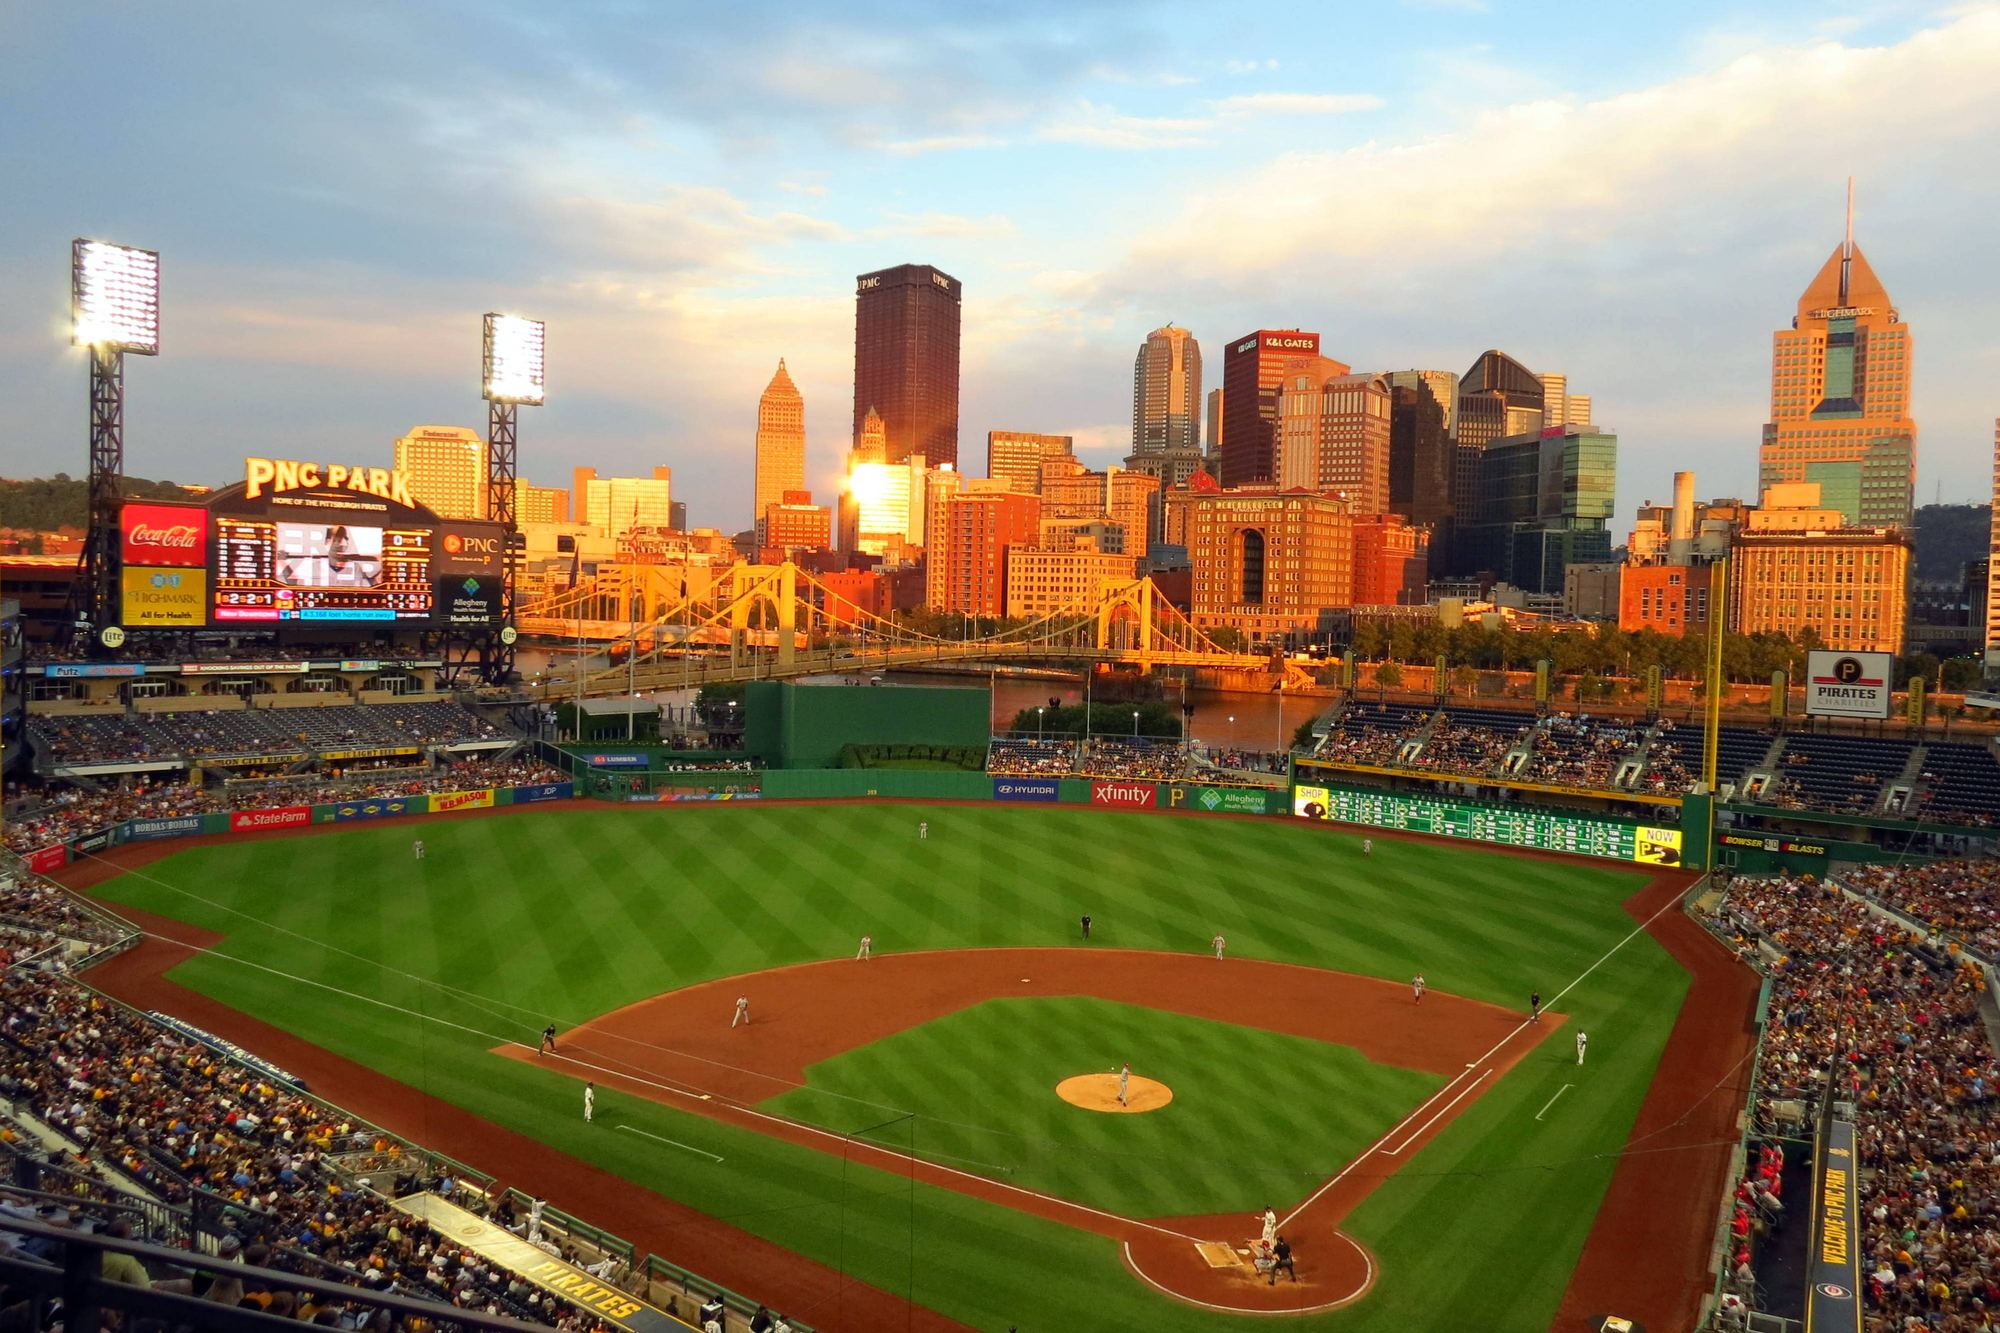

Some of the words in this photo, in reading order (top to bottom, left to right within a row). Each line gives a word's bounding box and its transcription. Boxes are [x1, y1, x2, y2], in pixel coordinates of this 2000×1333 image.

[932, 272, 950, 290] UPMC
[1266, 338, 1282, 346] K&L
[1284, 340, 1314, 349] GATES
[246, 457, 322, 500] PNC
[328, 464, 416, 510] PARK
[272, 497, 294, 505] HOME
[320, 500, 360, 509] PITTSBURGH
[361, 502, 387, 511] PIRATES
[129, 524, 200, 548] Coca-Cola
[463, 538, 498, 552] PNC
[484, 556, 490, 565] P
[134, 592, 198, 604] HIGHMARK
[230, 593, 239, 604] 2
[247, 594, 256, 604] 2
[264, 594, 271, 604] 1
[454, 599, 488, 607] Allegheny
[104, 632, 122, 642] Lite
[504, 631, 515, 640] Lite
[1842, 664, 1855, 679] P
[1818, 687, 1876, 699] PIRATES
[1818, 698, 1876, 707] CHARITIES
[543, 787, 556, 795] JDP
[1097, 785, 1150, 804] xfinity
[1170, 789, 1184, 806] P
[1301, 788, 1323, 798] SHOP
[1225, 794, 1265, 804] Allegheny
[1486, 809, 1556, 822] AMERICAN
[135, 822, 165, 833] BORDAS
[168, 819, 198, 829] BORDAS
[1568, 818, 1622, 829] LEAGUE
[1646, 829, 1674, 843] NOW
[1642, 843, 1650, 854] P
[1725, 837, 1763, 847] BOWSER
[1788, 844, 1824, 855] BLASTS
[1826, 1168, 1846, 1190] PARK
[1824, 1190, 1846, 1208] PNC
[1827, 1207, 1844, 1218] TO
[1823, 1217, 1847, 1265] WELCOME
[529, 1260, 642, 1320] PIRATES
